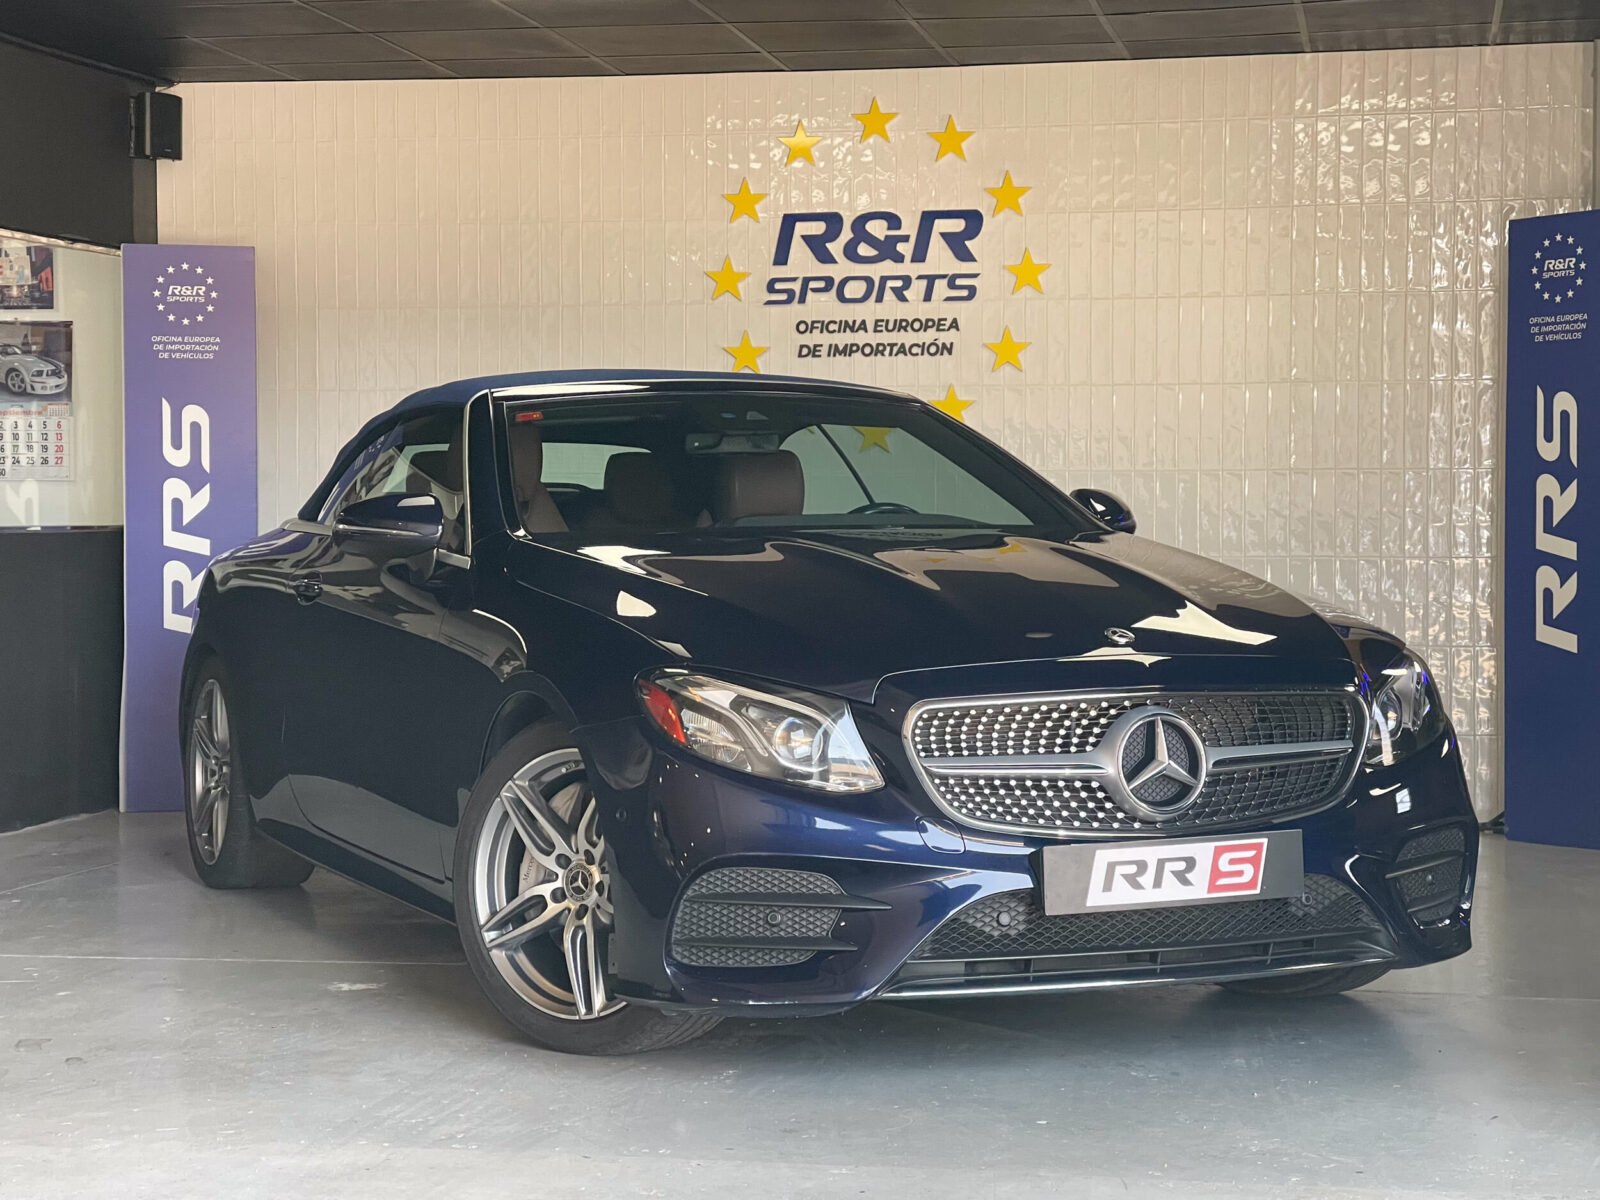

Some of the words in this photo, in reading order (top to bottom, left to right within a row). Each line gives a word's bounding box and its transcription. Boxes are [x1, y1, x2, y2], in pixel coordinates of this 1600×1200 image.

[772, 209, 984, 266] R&R
[1544, 257, 1576, 271] R&R
[1542, 269, 1575, 279] SPORTS
[168, 285, 206, 296] R&R
[763, 273, 981, 305] SPORTS
[1529, 316, 1555, 324] OFICINA
[1556, 313, 1588, 322] EUROPEA
[795, 319, 869, 334] OFICINA
[873, 317, 960, 333] EUROPEA
[1540, 322, 1587, 332] IMPORTACIÓN
[1545, 332, 1582, 341] VEHÍCULOS
[165, 343, 219, 351] IMPORTACIÓN
[797, 343, 822, 358] DE
[827, 339, 954, 357] IMPORTACIÓN
[171, 351, 214, 359] VEHÍCULOS
[13, 421, 18, 429] 3
[28, 421, 33, 429] 4
[42, 421, 47, 429] 5
[56, 421, 62, 429] 6
[11, 432, 20, 441] 10
[26, 432, 33, 441] 11
[41, 432, 49, 441] 12
[55, 432, 63, 441] 13
[12, 444, 20, 453] 17
[26, 444, 34, 453] 18
[41, 444, 48, 453] 19
[54, 444, 64, 453] 20
[11, 456, 20, 465] 24
[26, 456, 35, 465] 25
[40, 456, 49, 465] 26
[54, 456, 64, 465] 27
[162, 397, 211, 634] RRS
[1536, 385, 1578, 654] RRS
